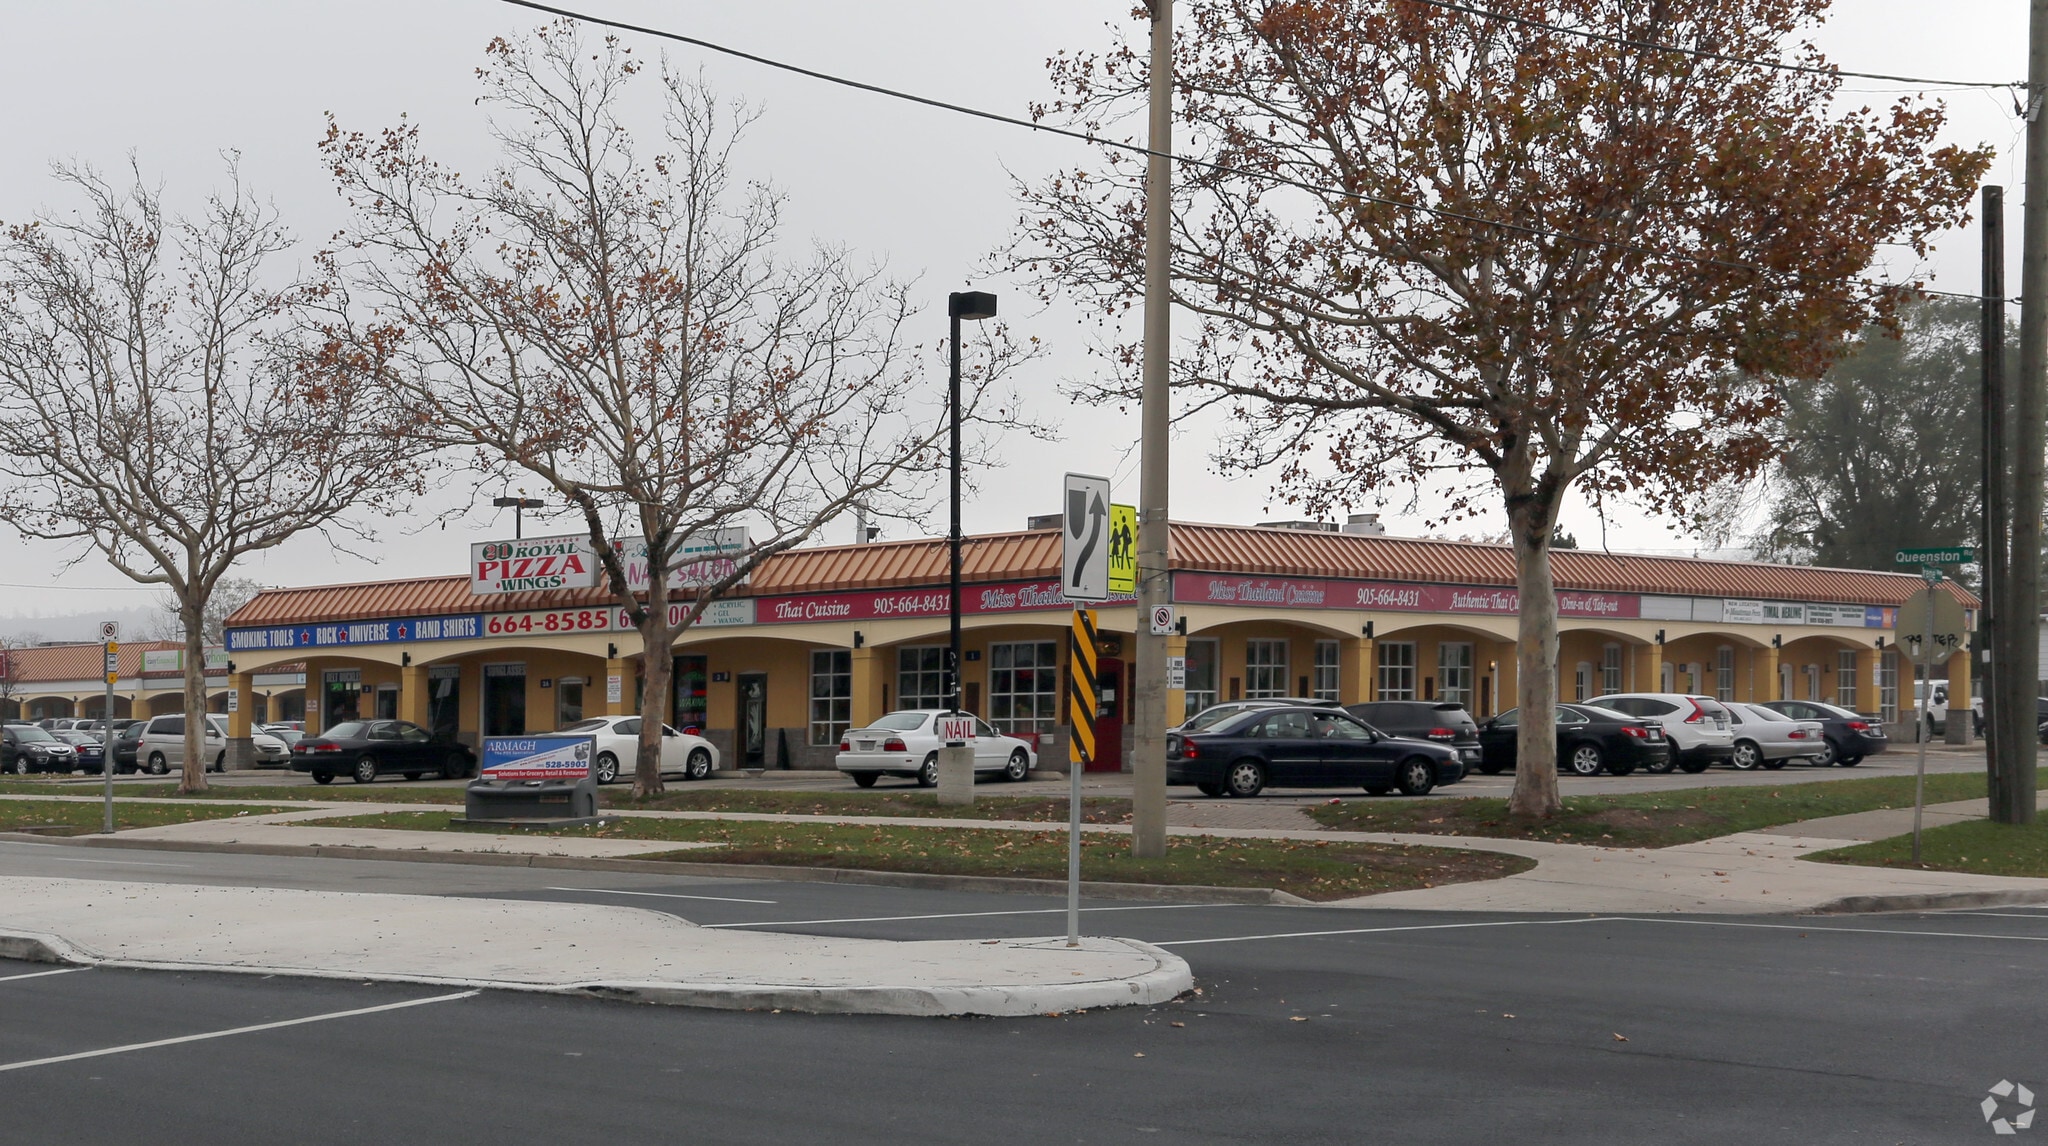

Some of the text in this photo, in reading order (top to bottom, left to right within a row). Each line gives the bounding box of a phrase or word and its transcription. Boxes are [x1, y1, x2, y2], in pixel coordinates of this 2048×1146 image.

[485, 542, 579, 560] 21 ROYAL
[1896, 551, 1960, 563] Queenston
[477, 554, 586, 581] PIZZA
[501, 575, 562, 592] WINGS
[1208, 580, 1324, 605] Miss Thailand Cuisine
[873, 594, 950, 615] 905-664-8431
[980, 588, 1016, 609] Miss
[1018, 583, 1076, 607] Thaila
[1357, 587, 1419, 607] 905-664-8431
[1449, 592, 1489, 610] Authentic
[1491, 592, 1508, 609] Thai
[775, 600, 850, 619] Thai Cuisine
[488, 610, 608, 635] 664-8585
[231, 618, 476, 649] SMOKING TOOLS ROCK UNIVERSE BAND SHIRTS
[945, 721, 976, 739] NAIL
[487, 741, 536, 752] ARMAGH
[545, 760, 587, 768] 528-5903
